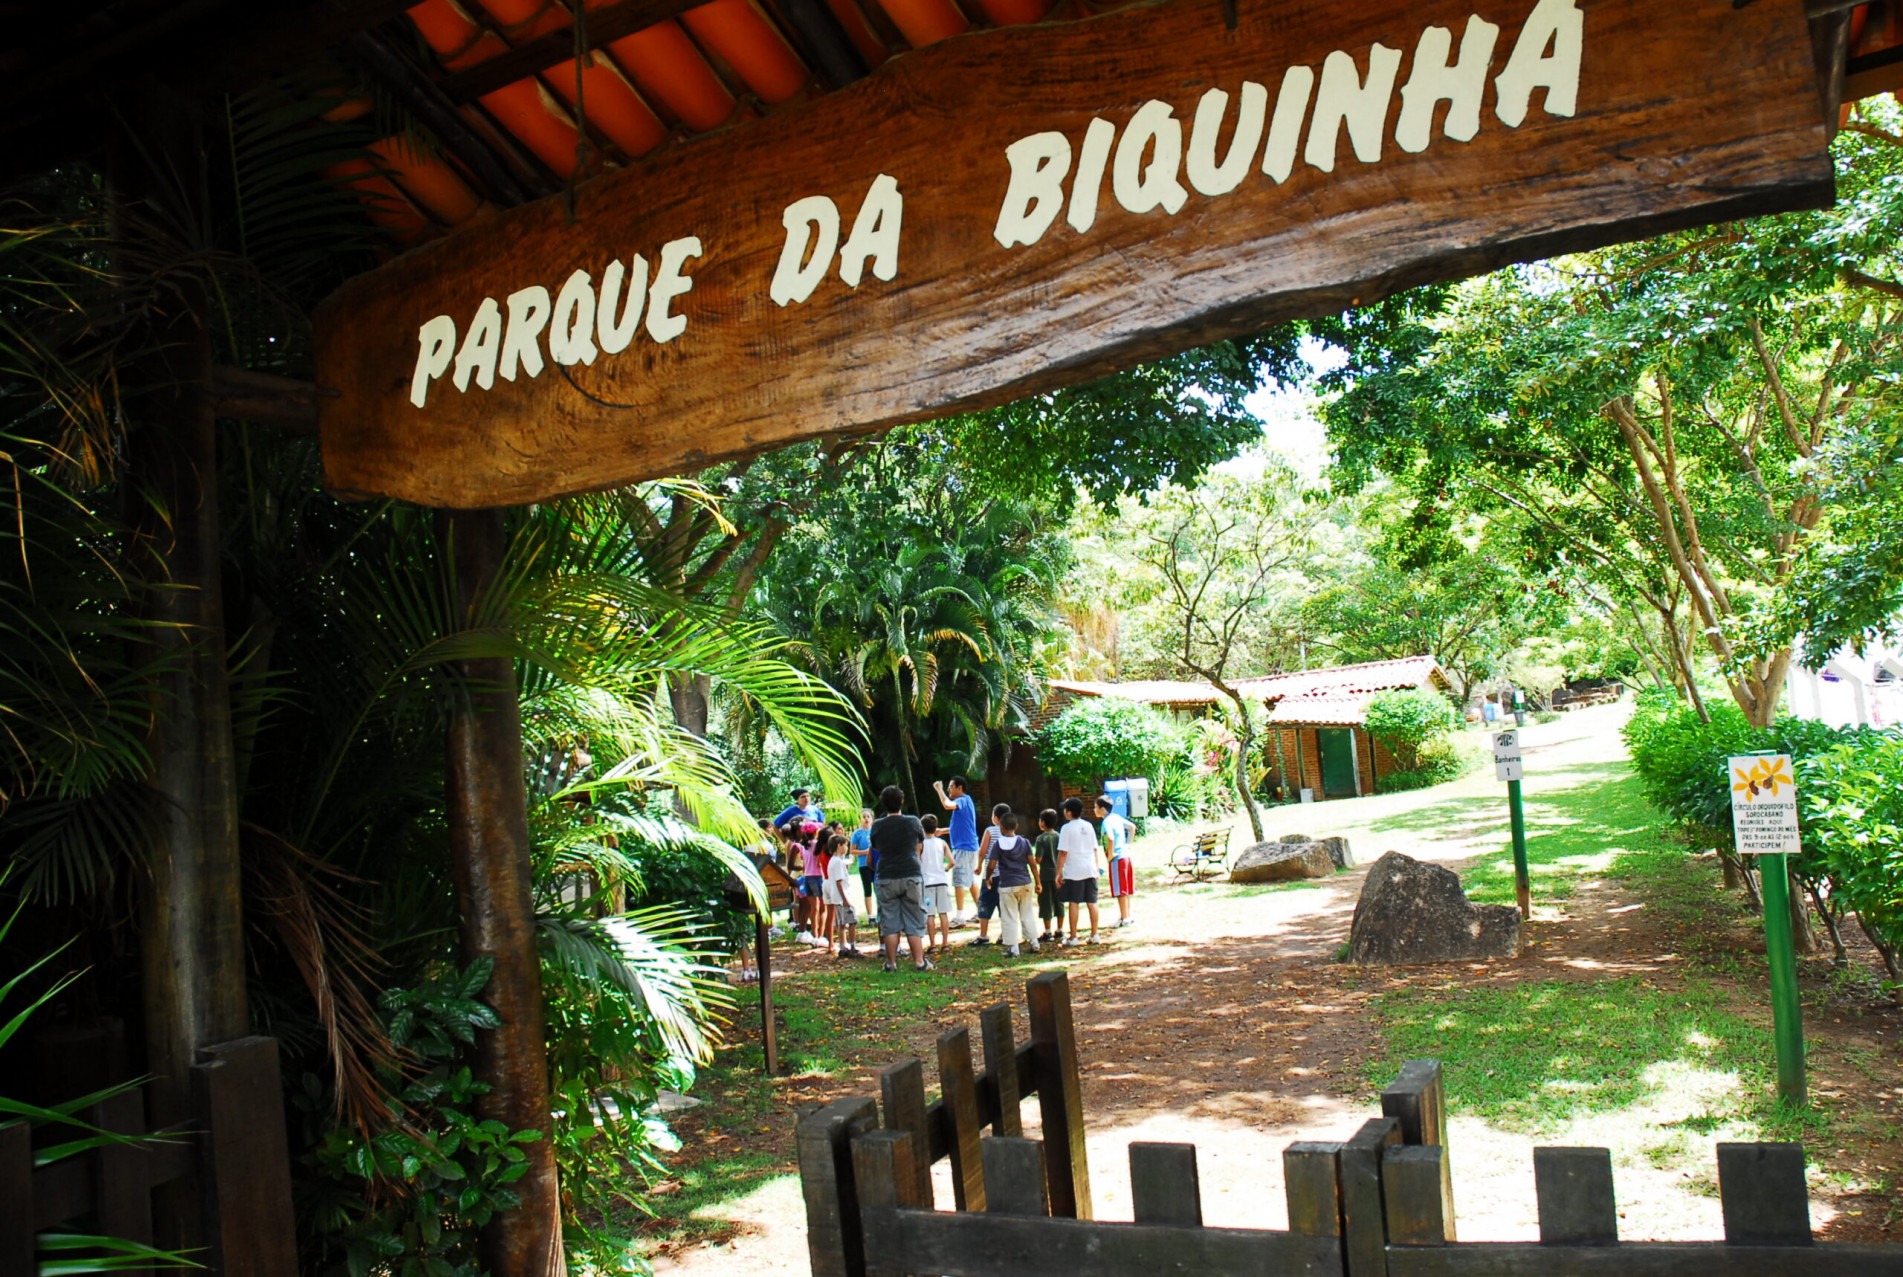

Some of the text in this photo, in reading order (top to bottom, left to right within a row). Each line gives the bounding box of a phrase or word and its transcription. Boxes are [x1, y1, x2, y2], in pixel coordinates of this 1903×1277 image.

[411, 0, 1584, 408] PARQUE DA BIQUINHA
